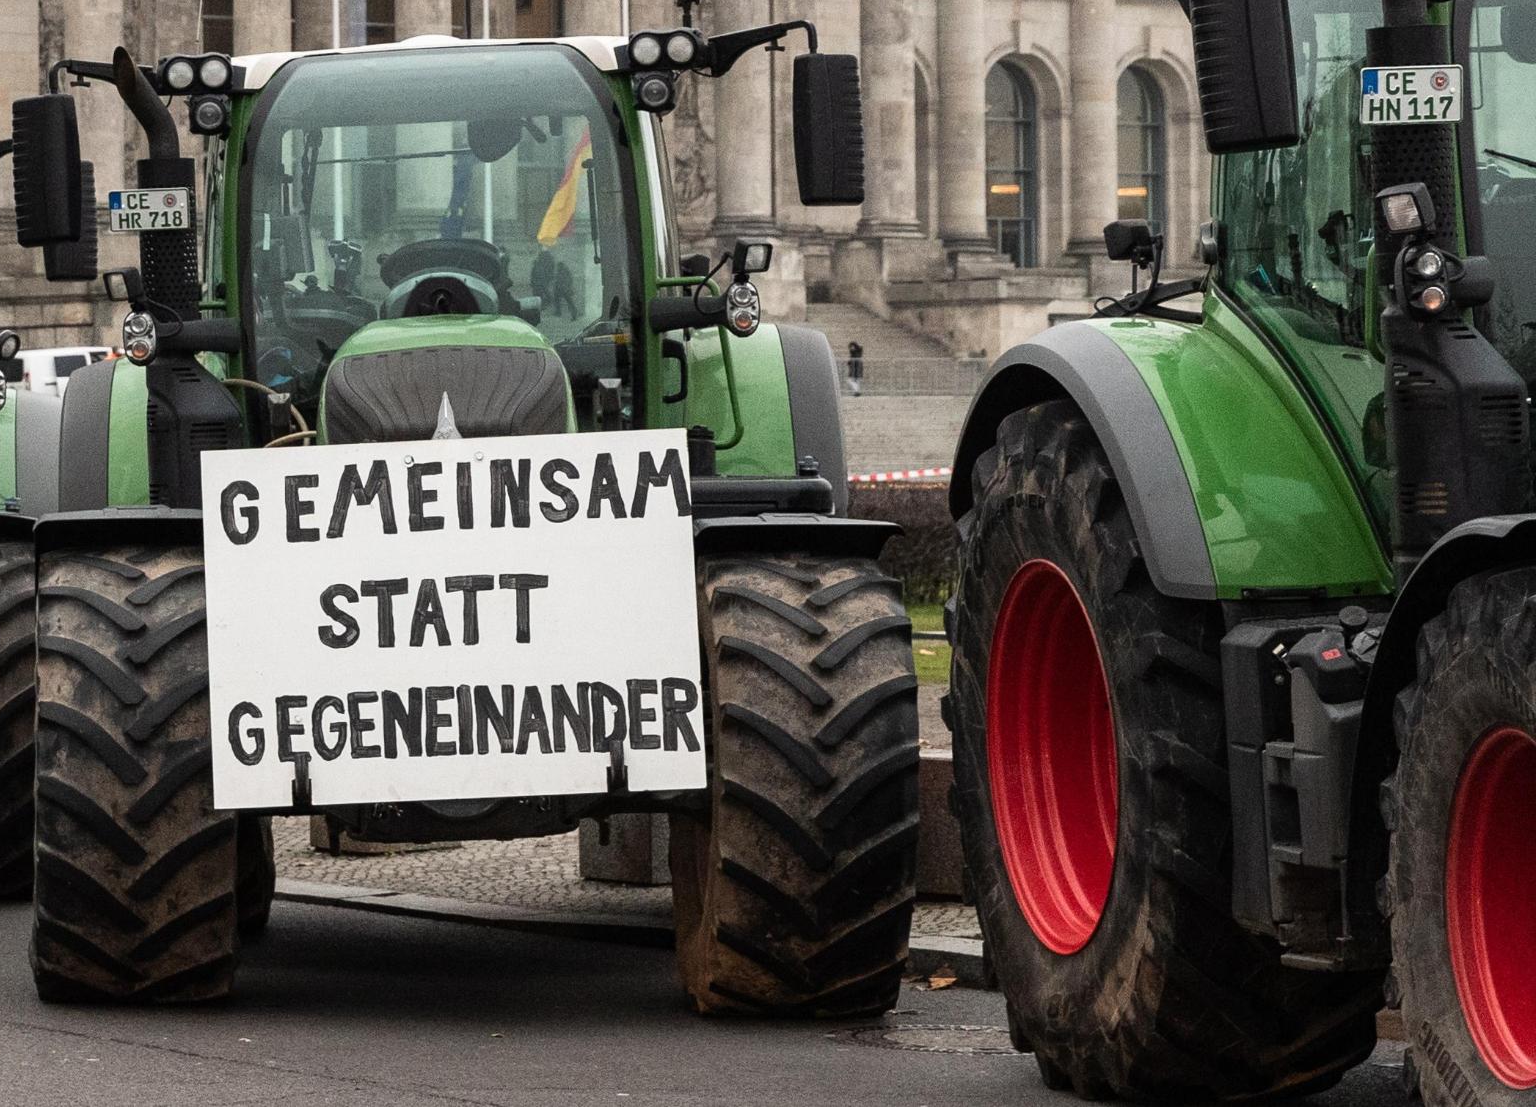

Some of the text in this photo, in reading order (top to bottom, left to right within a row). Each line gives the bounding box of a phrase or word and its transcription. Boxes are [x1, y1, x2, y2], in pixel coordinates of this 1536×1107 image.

[1385, 72, 1417, 95] CE
[1369, 96, 1453, 121] HN 117
[127, 193, 150, 209] CE
[119, 210, 182, 229] HR 718
[220, 449, 692, 545] GEMEINSAM
[318, 574, 548, 648] STATT
[228, 677, 700, 765] GEGENEINANDER
